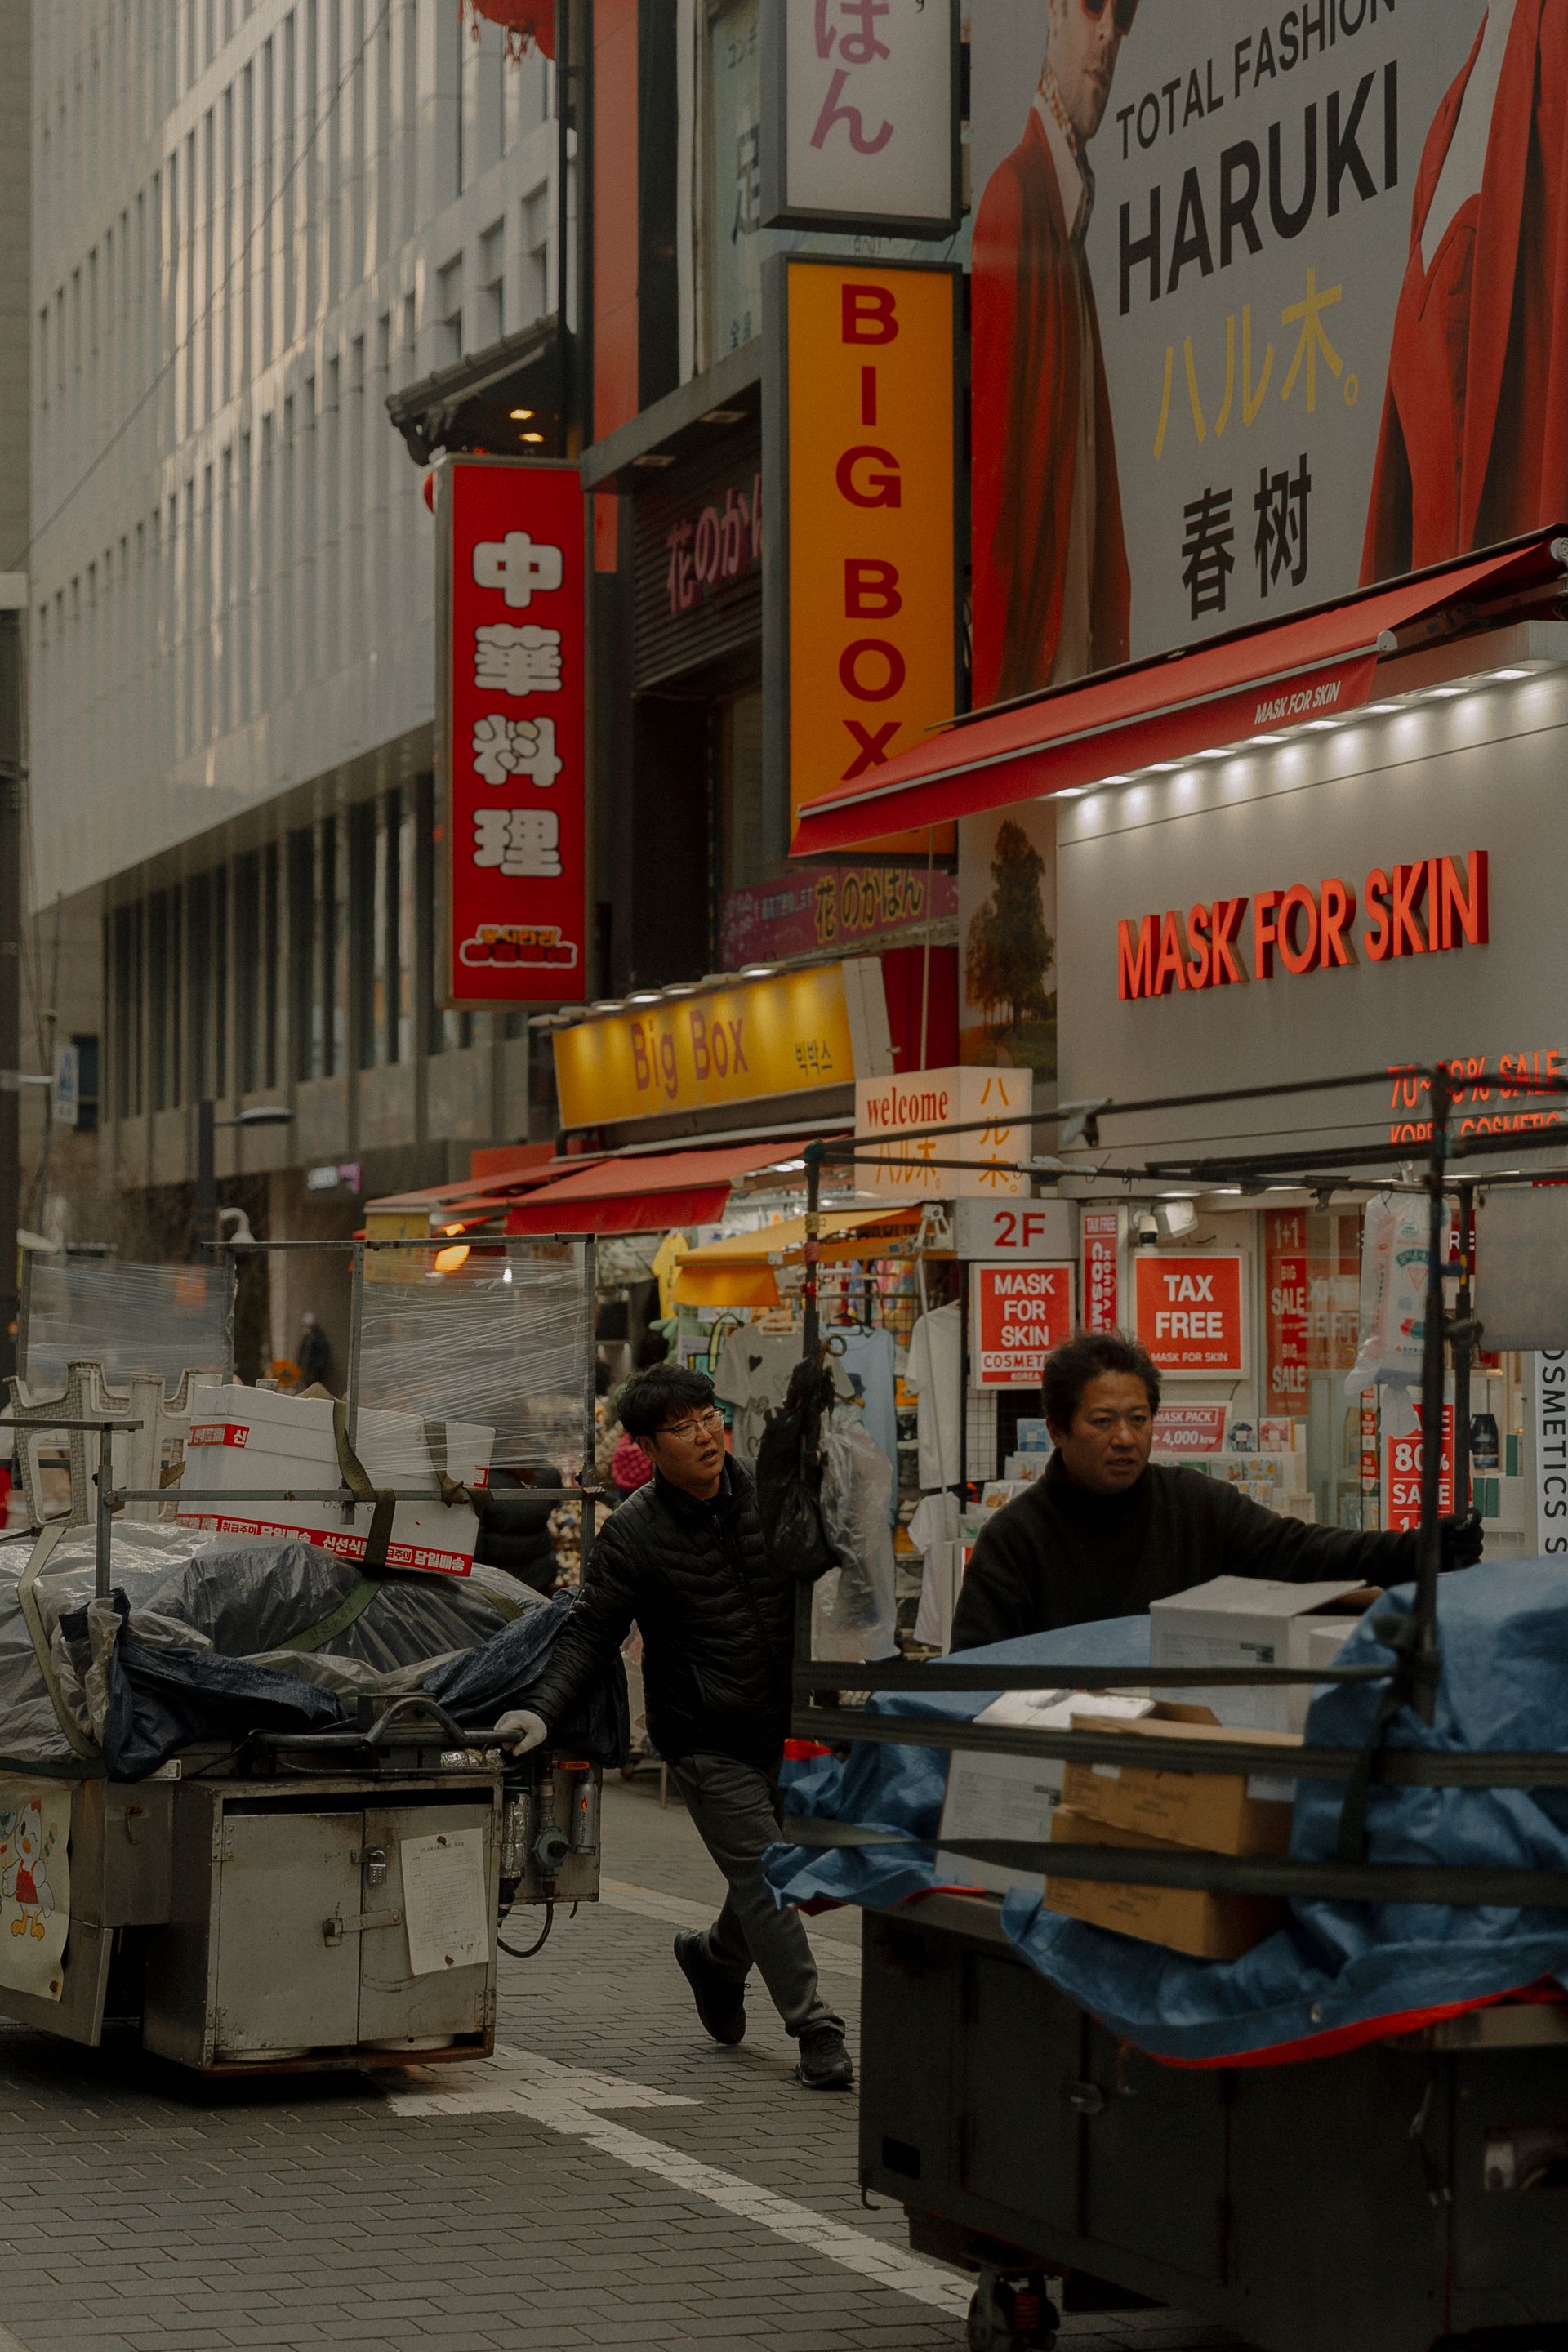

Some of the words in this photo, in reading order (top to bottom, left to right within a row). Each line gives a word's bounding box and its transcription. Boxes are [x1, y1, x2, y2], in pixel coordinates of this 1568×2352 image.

[1116, 58, 1223, 160] TOTAL
[1120, 59, 1398, 317] HARUKI
[1153, 268, 1360, 462] ハル木。
[835, 283, 902, 510] BIG
[666, 472, 763, 614] 花のか
[1181, 452, 1312, 621] 春树
[838, 558, 906, 782] BOX
[472, 530, 564, 878] 中華料理
[1254, 696, 1288, 725] MASK
[1286, 689, 1313, 715] FOR
[1312, 680, 1342, 708] SKIN
[1118, 897, 1250, 1000] MASK
[1254, 878, 1357, 980] FOR
[1363, 850, 1489, 962] SKIN
[630, 1021, 678, 1100] Big
[689, 1009, 750, 1080] Box
[1387, 1056, 1490, 1109] 70~0%
[1499, 1049, 1560, 1099] SALE
[866, 1086, 949, 1127] welcome
[1389, 1121, 1448, 1146] KORE
[993, 1211, 1046, 1247] 2F
[1086, 1216, 1098, 1233] TAX
[1100, 1215, 1116, 1233] FREE
[1274, 1216, 1299, 1250] 1+1
[994, 1273, 1056, 1295] MASK
[1102, 1250, 1112, 1310] KOREA
[1280, 1264, 1297, 1281] BIG
[1163, 1274, 1214, 1302] TAX
[1271, 1286, 1306, 1316] SALE
[1004, 1299, 1046, 1321] FOR
[1000, 1325, 1049, 1348] SKIN
[1155, 1311, 1224, 1339] FREE
[983, 1354, 1046, 1369] COSMET
[1151, 1352, 1180, 1363] MASK
[1182, 1352, 1203, 1363] FOR
[1205, 1352, 1228, 1363] SKIN
[1281, 1343, 1298, 1360] BIG
[1272, 1365, 1306, 1393] SALE
[1185, 1410, 1213, 1423] PACK
[233, 1429, 247, 1446] 신
[1162, 1429, 1200, 1446] 4,000
[1200, 1434, 1217, 1446] krw
[1392, 1483, 1450, 1506] SAE
[1545, 1537, 1567, 1554] S
[414, 1549, 466, 1572] 당일배송
